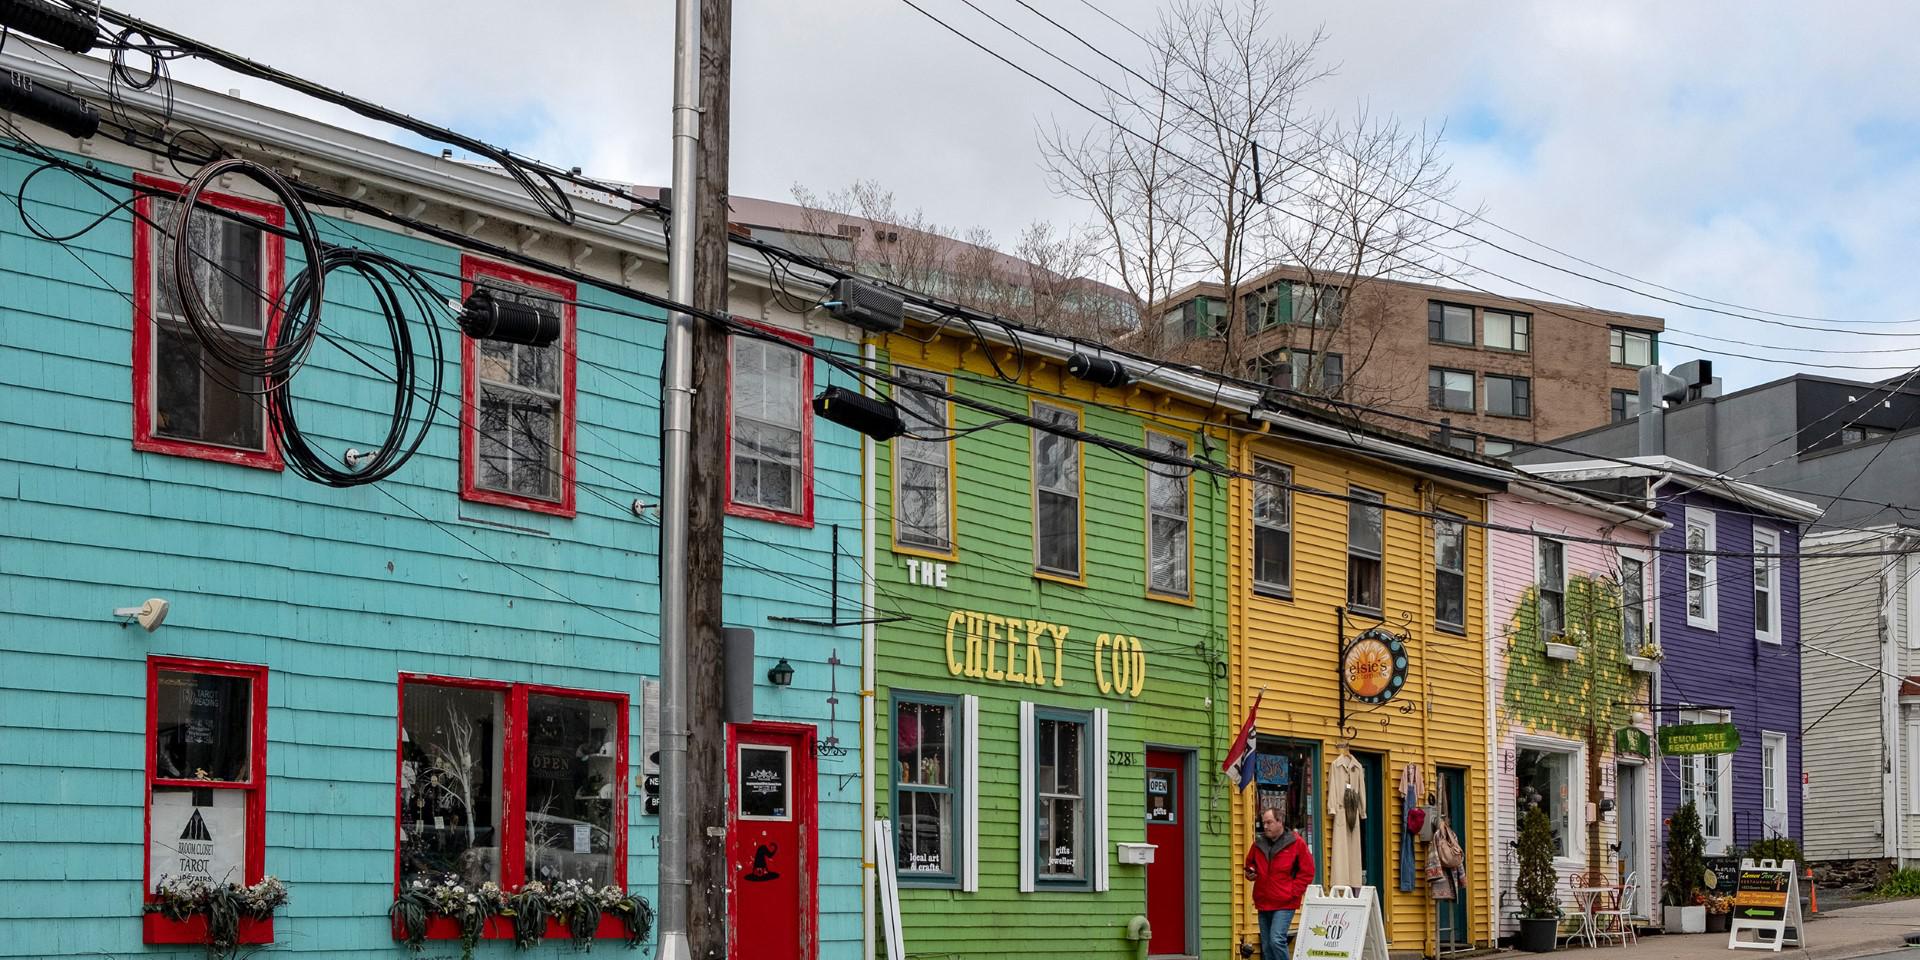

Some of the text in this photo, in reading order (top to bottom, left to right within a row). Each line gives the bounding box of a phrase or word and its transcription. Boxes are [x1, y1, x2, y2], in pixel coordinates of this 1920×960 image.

[906, 558, 948, 588] THE
[945, 609, 1146, 698] CHEEKY COD
[1349, 659, 1388, 674] elsie's
[197, 689, 219, 698] TAROT
[1668, 733, 1726, 743] LEMON TREE
[1668, 741, 1726, 752] RESTAURANT
[532, 756, 569, 769] OPEN
[1150, 781, 1166, 791] OPEN
[1153, 807, 1167, 816] gifts
[178, 842, 214, 855] BROOM CLOSET
[1055, 846, 1070, 856] gifts
[909, 852, 940, 862] local art
[1047, 856, 1077, 867] jewellery
[179, 858, 210, 872] TAROT
[910, 863, 940, 872] & crafts
[1325, 925, 1343, 940] COD
